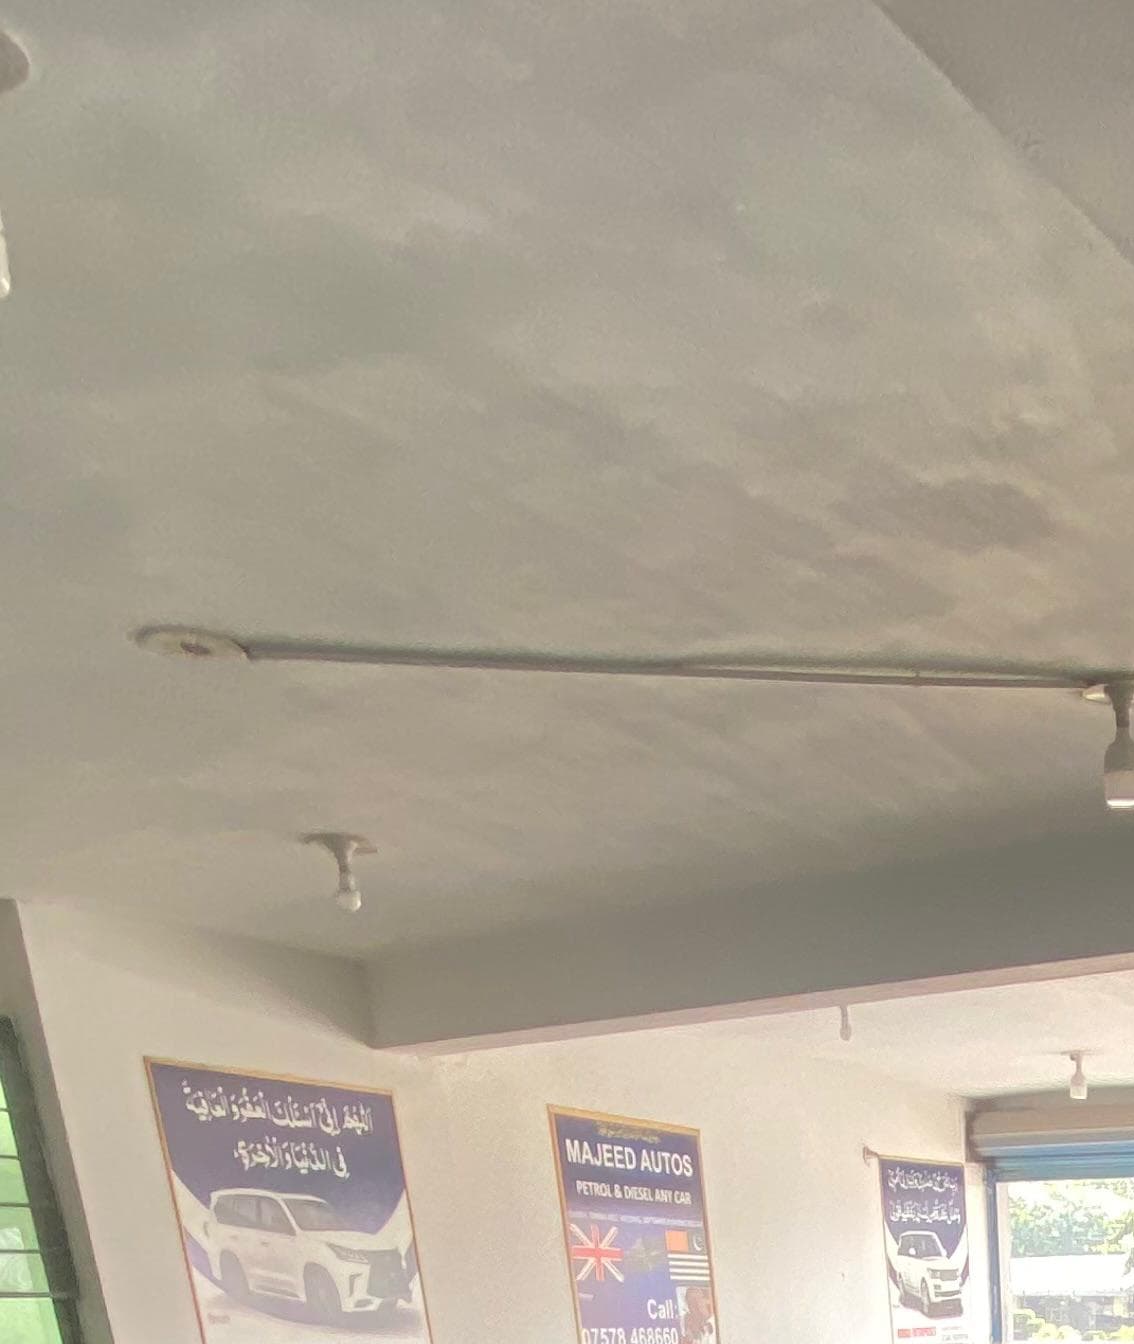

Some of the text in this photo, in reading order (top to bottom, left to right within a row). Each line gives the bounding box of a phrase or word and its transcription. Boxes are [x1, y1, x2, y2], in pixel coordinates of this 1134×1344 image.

[565, 1139, 693, 1177] MAJEED AUTOS
[576, 1180, 692, 1205] PETROL & DIESEL ANY CAR
[647, 1299, 679, 1319] Call:
